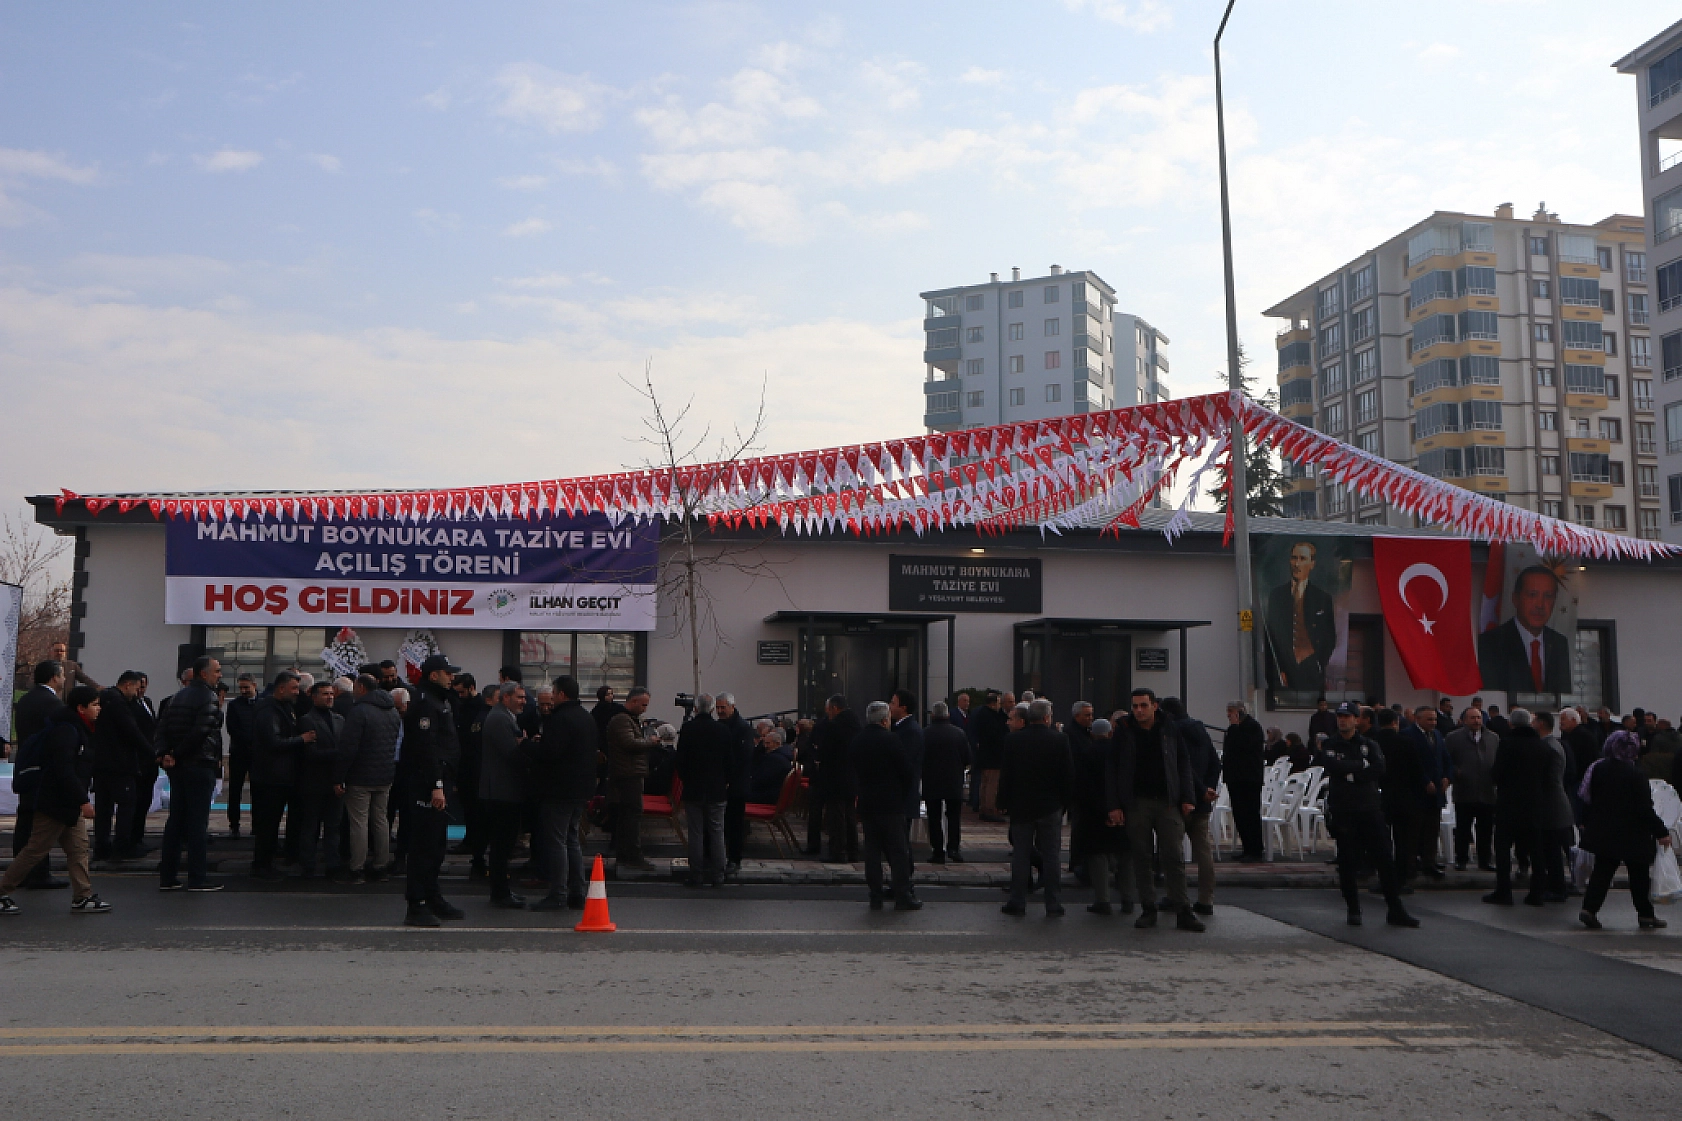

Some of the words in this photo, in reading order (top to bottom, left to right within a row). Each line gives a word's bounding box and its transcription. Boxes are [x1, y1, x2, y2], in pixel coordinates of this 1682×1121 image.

[197, 521, 315, 544] MAHMUT
[321, 524, 488, 547] BOYNUKARA
[494, 526, 585, 549] TAZİYE
[591, 527, 632, 549] EVİ
[314, 551, 407, 577] AÇILIŞ
[415, 549, 520, 575] TÖRENİ
[901, 564, 956, 576] MAHMUT
[959, 566, 1031, 578] BOYNUKARA
[932, 578, 977, 591] TAZİYE
[204, 584, 290, 616] HOŞ
[297, 586, 475, 615] GELDİNİZ
[529, 595, 574, 609] İLHAN
[576, 596, 622, 612] GEÇİT
